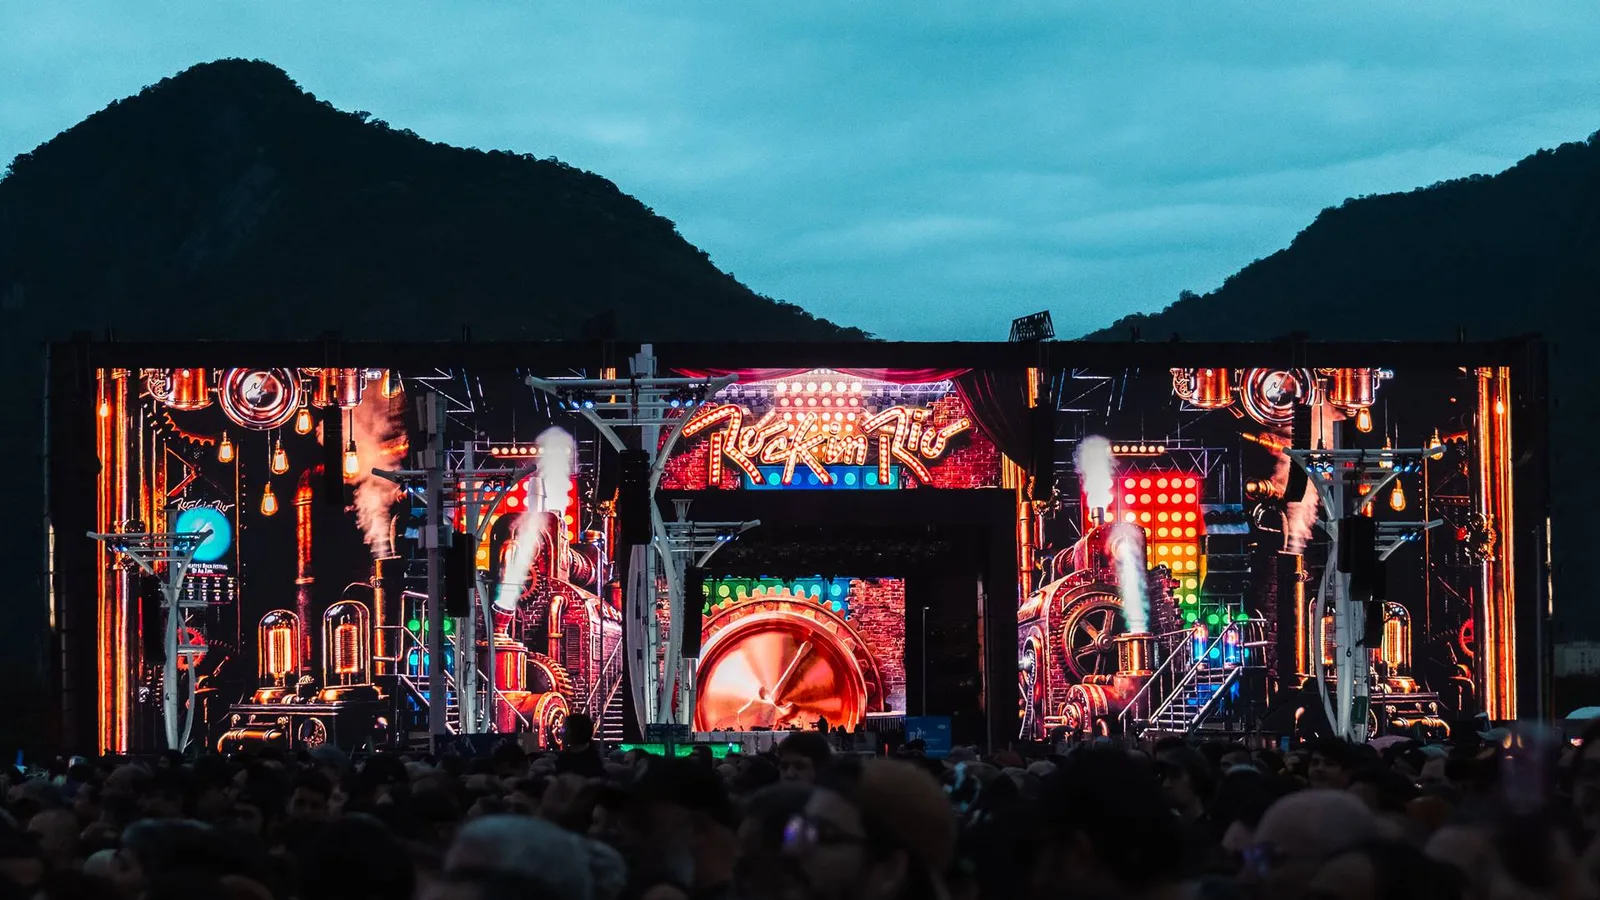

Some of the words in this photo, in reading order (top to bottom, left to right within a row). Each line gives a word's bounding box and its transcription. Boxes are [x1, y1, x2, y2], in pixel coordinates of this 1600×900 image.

[682, 403, 834, 485] Rock
[824, 422, 869, 466] in
[860, 405, 971, 485] Rio
[1346, 646, 1352, 658] 6
[684, 682, 691, 691] 3
